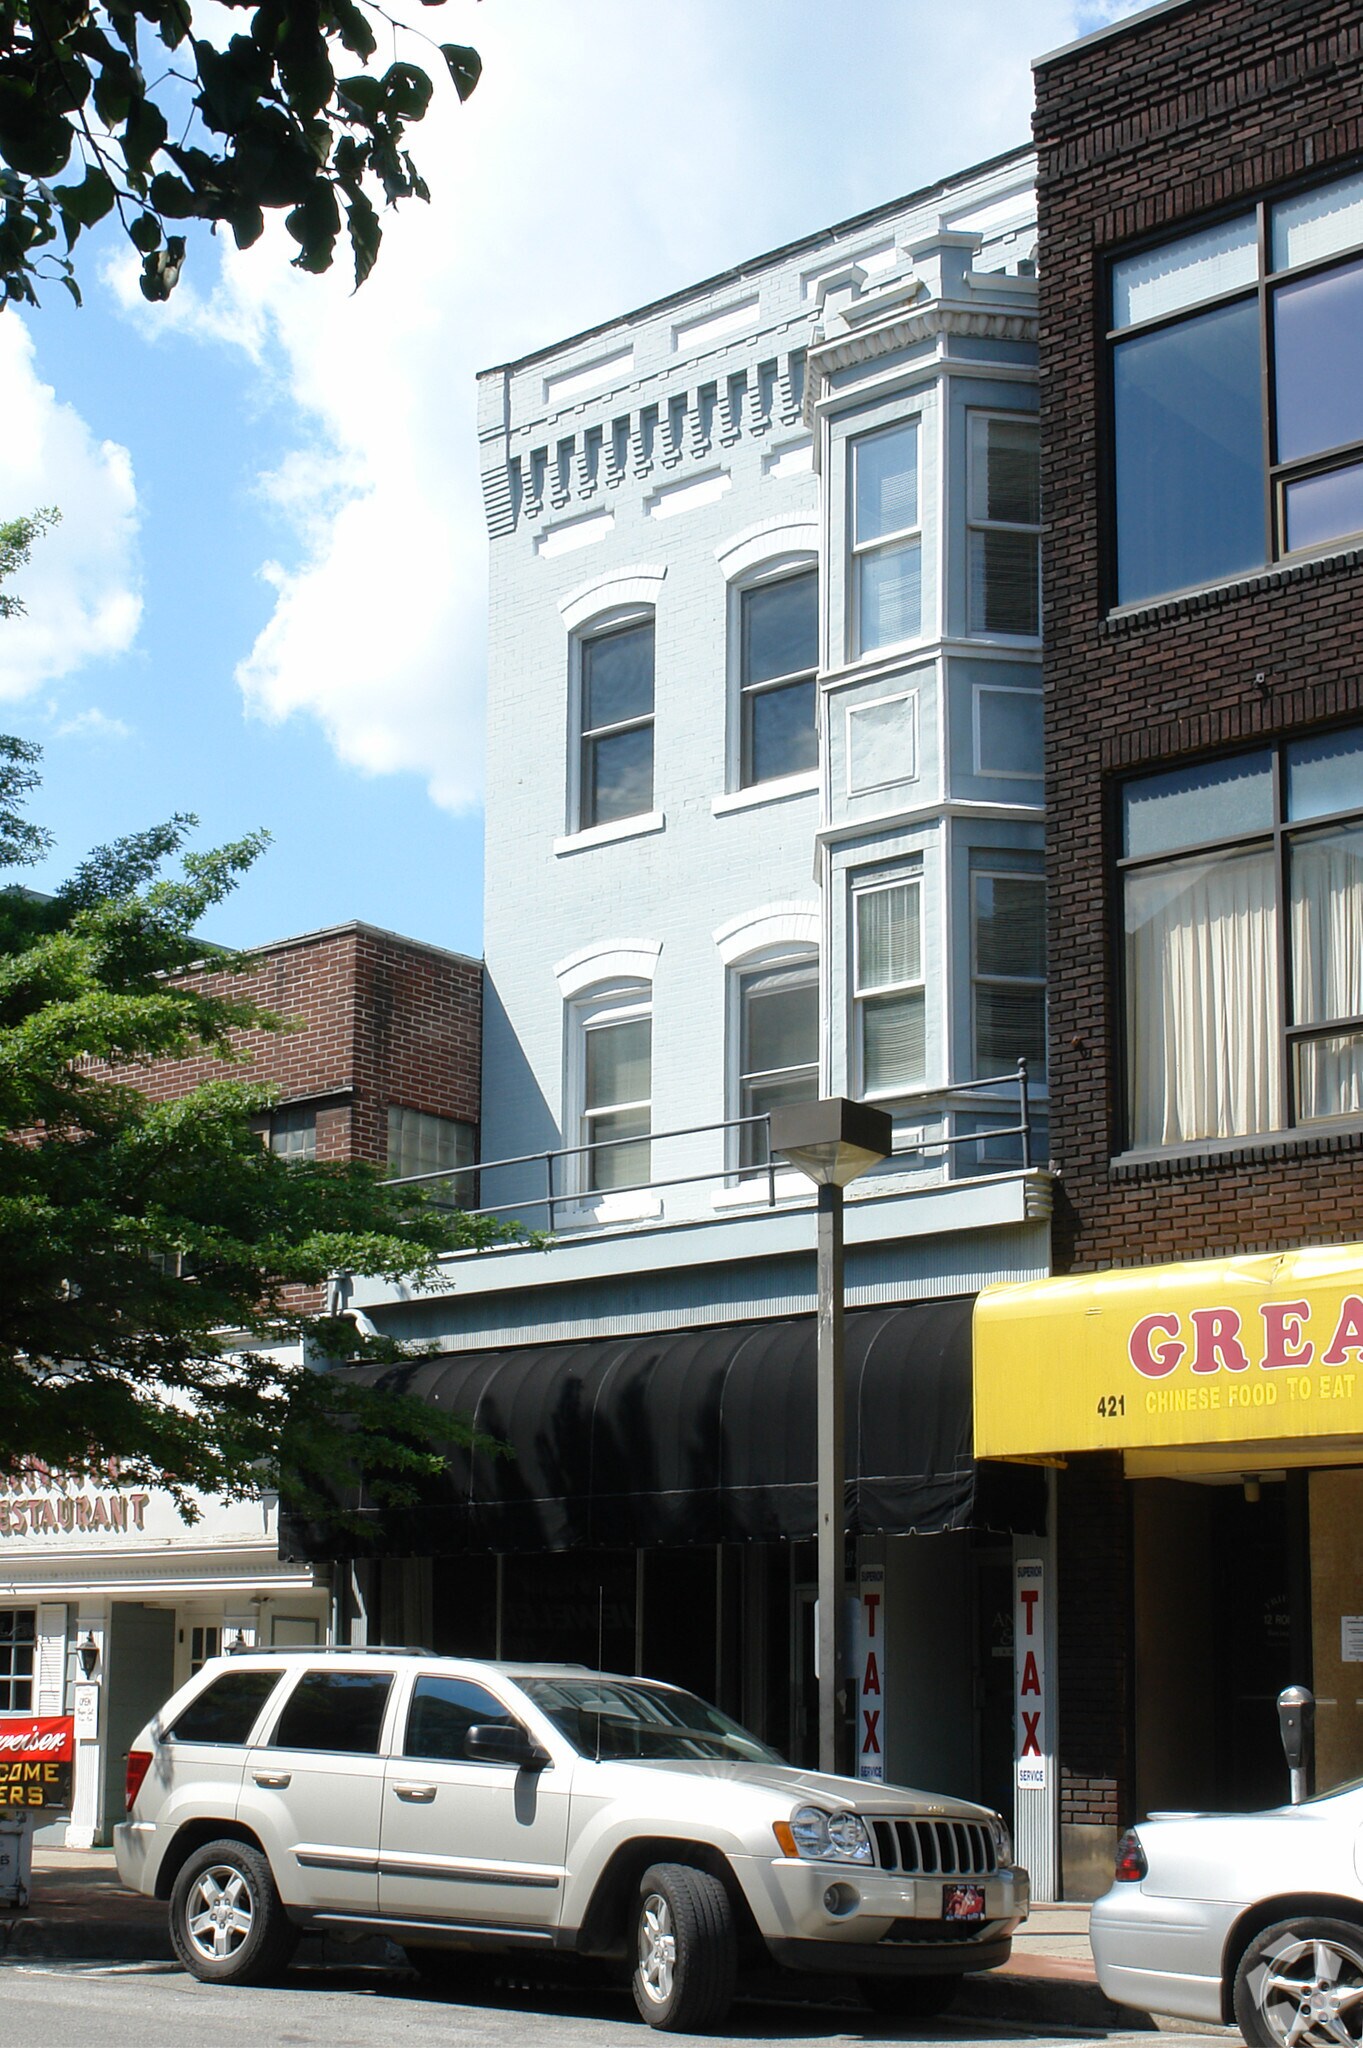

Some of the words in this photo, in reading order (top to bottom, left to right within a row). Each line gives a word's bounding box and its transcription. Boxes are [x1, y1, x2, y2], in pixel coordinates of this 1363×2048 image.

[1127, 1295, 1363, 1379] GREA
[1097, 1395, 1125, 1417] 421
[1145, 1387, 1220, 1414] CHINESE
[1228, 1382, 1277, 1407] FOOD
[1286, 1376, 1312, 1400] TO
[1320, 1374, 1356, 1399] EAT
[1017, 1566, 1042, 1578] SUPERIOR
[862, 1594, 881, 1754] TAX
[1020, 1590, 1042, 1757] TAX
[1019, 1770, 1044, 1782] SERVICE
